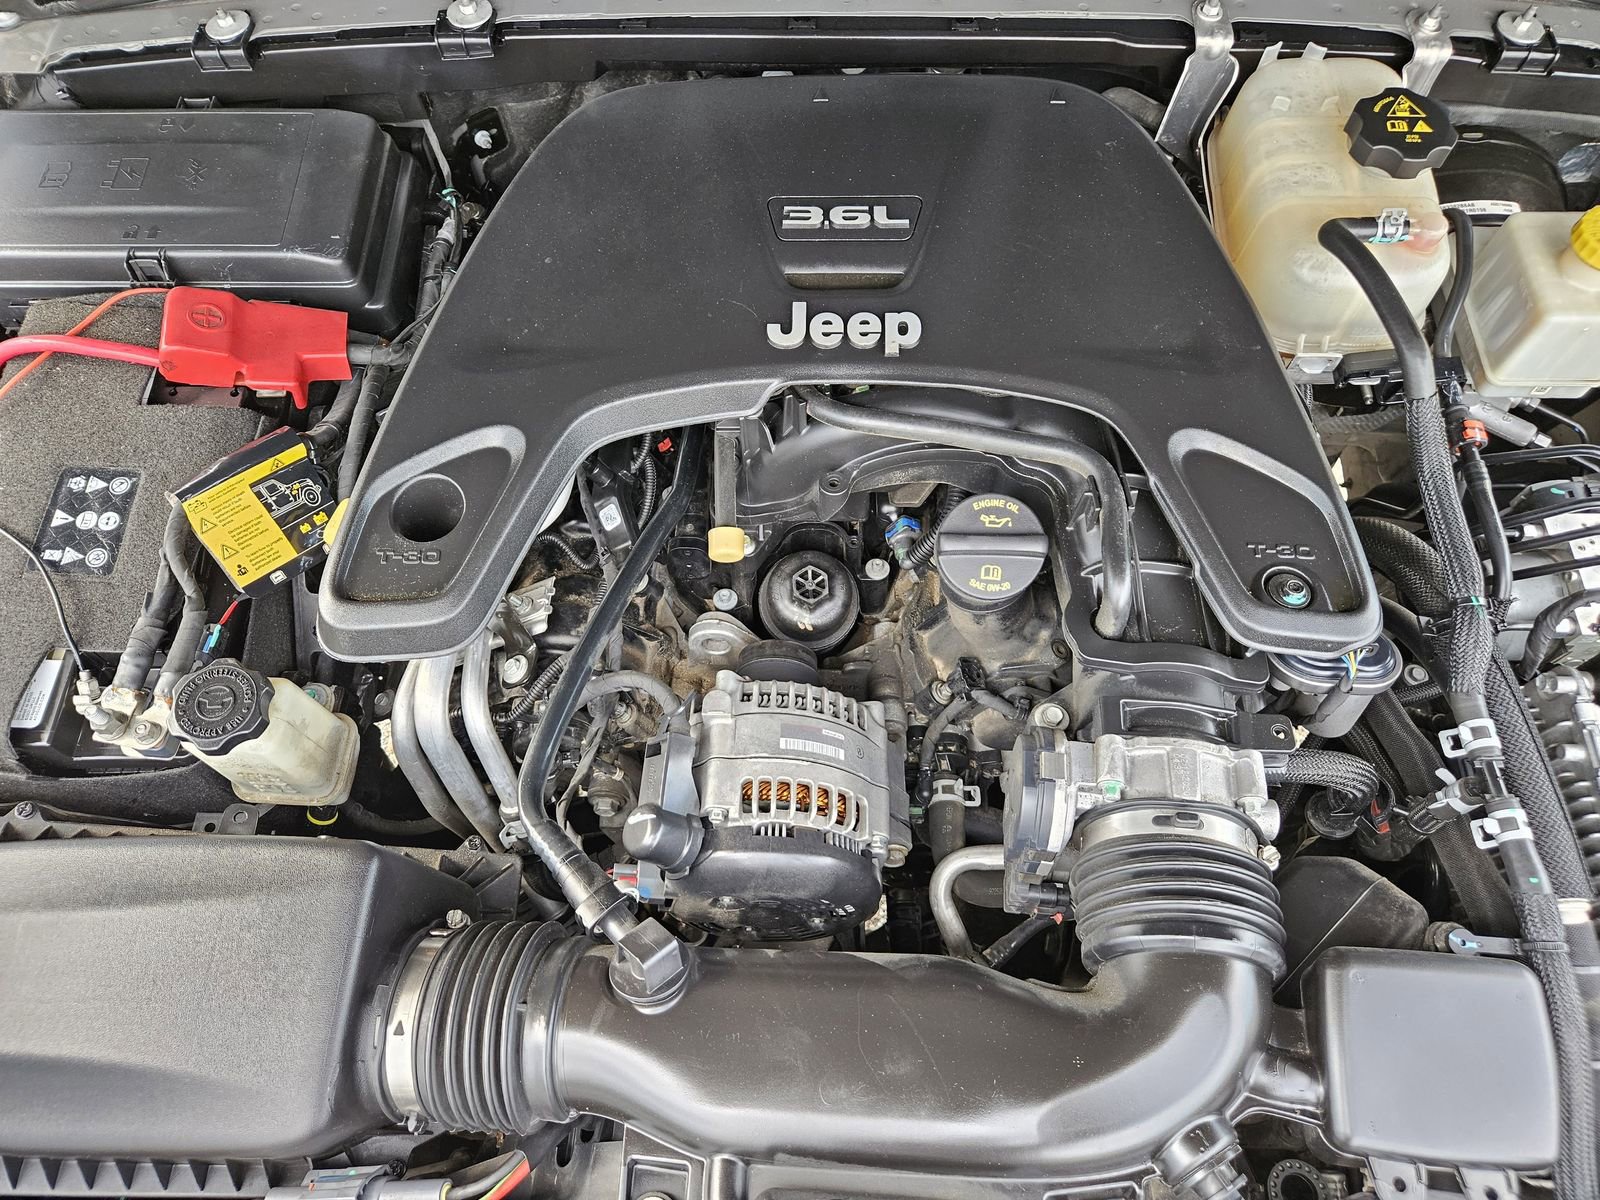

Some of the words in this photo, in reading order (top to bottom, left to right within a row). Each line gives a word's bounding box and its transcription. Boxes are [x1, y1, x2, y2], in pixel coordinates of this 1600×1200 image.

[782, 205, 910, 229] 3.6L
[766, 301, 922, 358] Jeep
[972, 498, 1006, 511] ENGINE
[1006, 502, 1020, 514] OIL
[375, 547, 441, 565] T-30
[1246, 542, 1317, 560] T-30
[969, 578, 986, 591] SAE
[986, 581, 1011, 592] 0W-20
[195, 668, 239, 684] STEERING
[178, 681, 197, 706] FLUID
[236, 674, 253, 703] POWER
[180, 717, 225, 737] APPROVED
